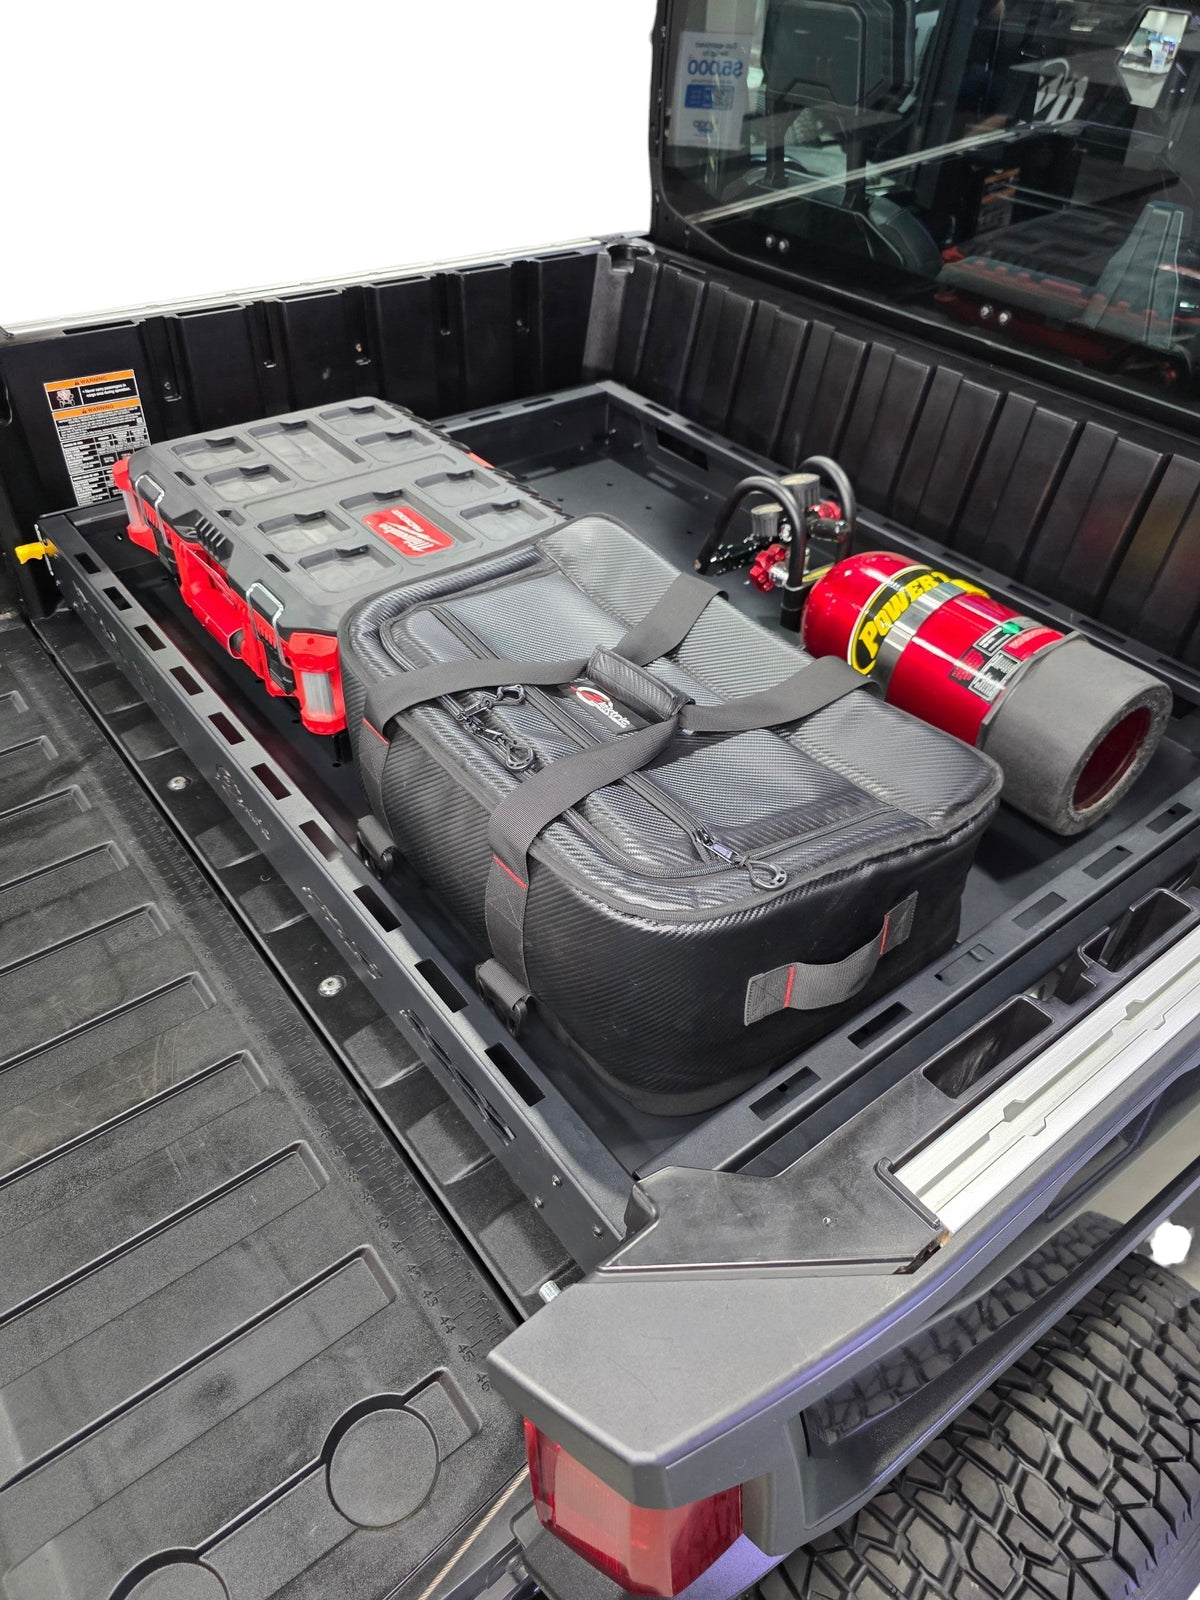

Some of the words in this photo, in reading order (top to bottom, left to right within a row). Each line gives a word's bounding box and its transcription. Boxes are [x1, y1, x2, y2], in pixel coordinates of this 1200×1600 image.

[80, 376, 107, 385] WARNING
[88, 404, 114, 412] WARNING
[375, 1215, 389, 1230] 40
[391, 1240, 404, 1255] 41
[406, 1263, 422, 1282] 42
[423, 1289, 439, 1307] 43
[440, 1315, 456, 1334] 44
[458, 1343, 476, 1363] 45
[476, 1371, 490, 1393] 46
